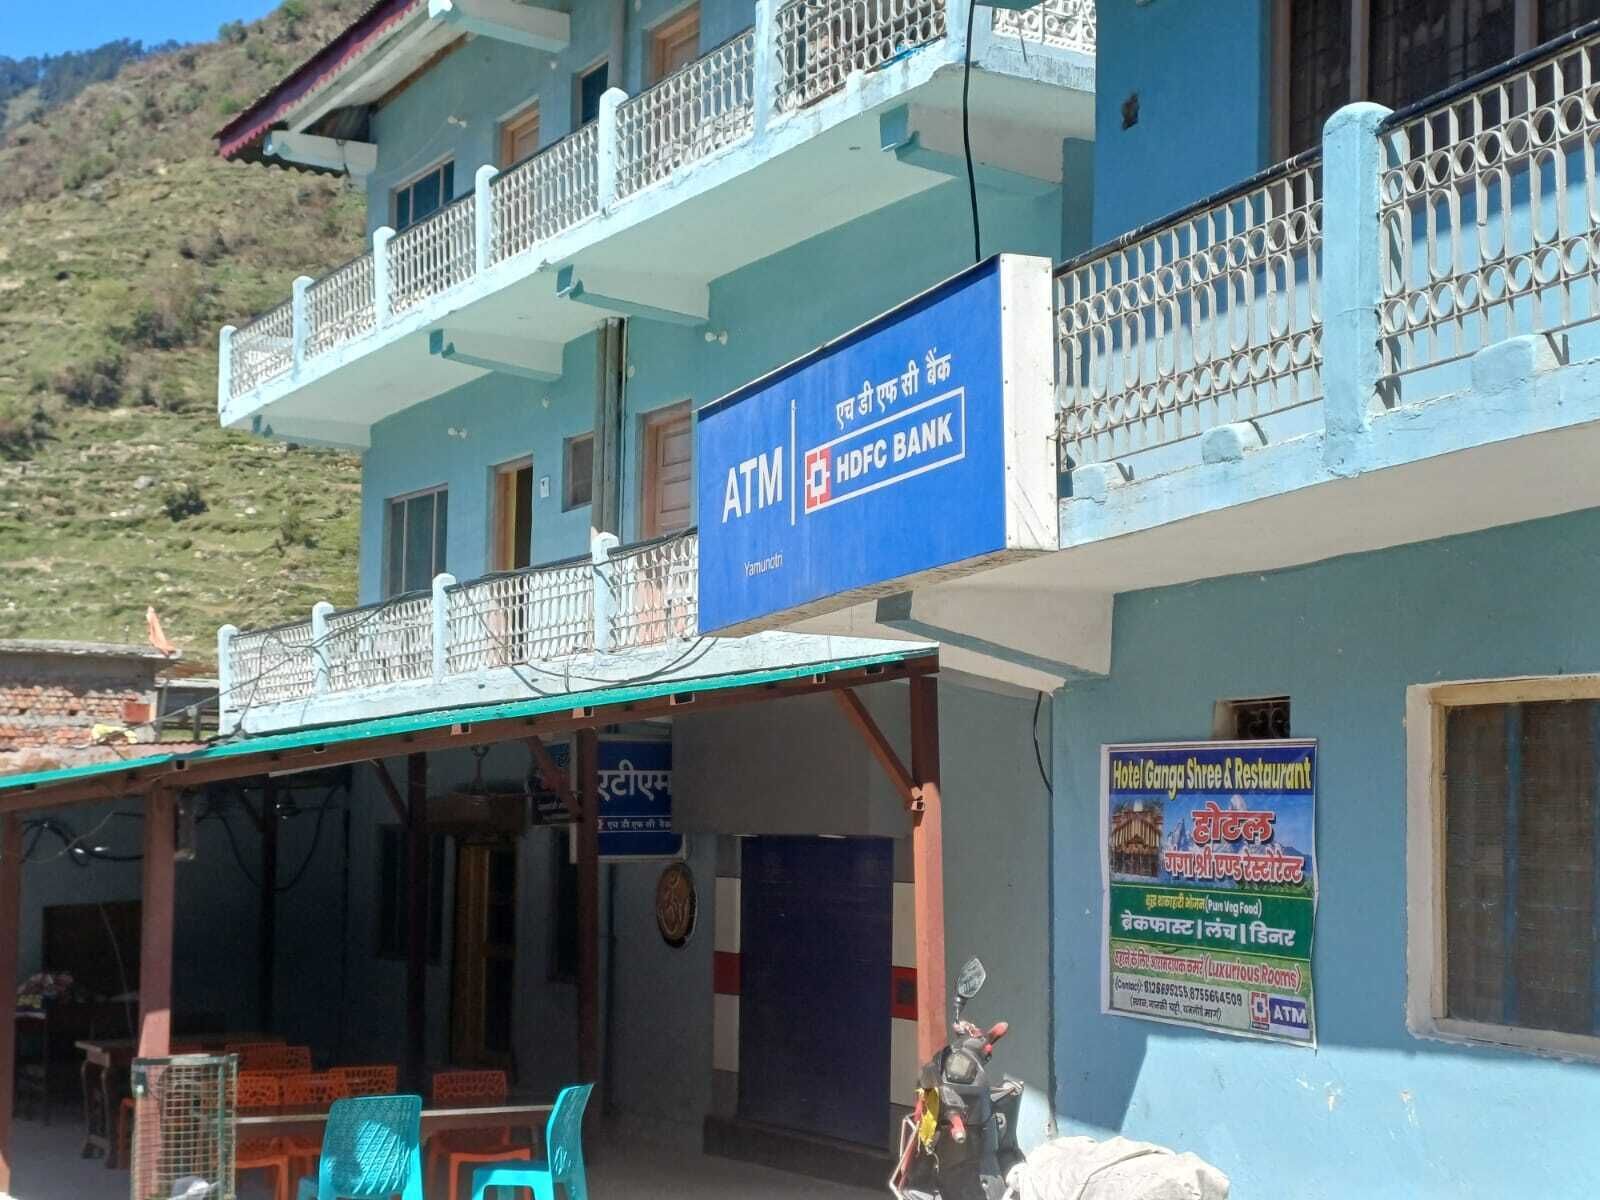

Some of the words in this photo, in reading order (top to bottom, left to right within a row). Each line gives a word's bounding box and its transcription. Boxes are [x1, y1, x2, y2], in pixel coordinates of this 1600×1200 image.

[836, 397, 855, 430] एच
[858, 380, 873, 415] डी
[876, 378, 898, 413] एफ
[901, 360, 919, 396] सी
[925, 347, 951, 385] बैंक
[836, 442, 887, 484] HDFC
[893, 413, 953, 463] BANK
[721, 446, 783, 524] ATM
[744, 550, 783, 577] Yamunotri
[1114, 759, 1143, 790] Hotel
[1145, 759, 1185, 800] Ganga
[1187, 757, 1222, 789] Shree
[1224, 760, 1231, 789] &
[1235, 757, 1312, 790] Restaurant
[1191, 801, 1276, 844] होटल
[1194, 847, 1213, 879] श्री
[1215, 852, 1241, 882] एण्ड
[1120, 910, 1194, 936] ब्रेकफास्ट
[1204, 917, 1236, 941] लंच
[1249, 921, 1296, 947] डिनर
[1224, 900, 1239, 917] Veg
[1274, 1004, 1307, 1024] ATM
